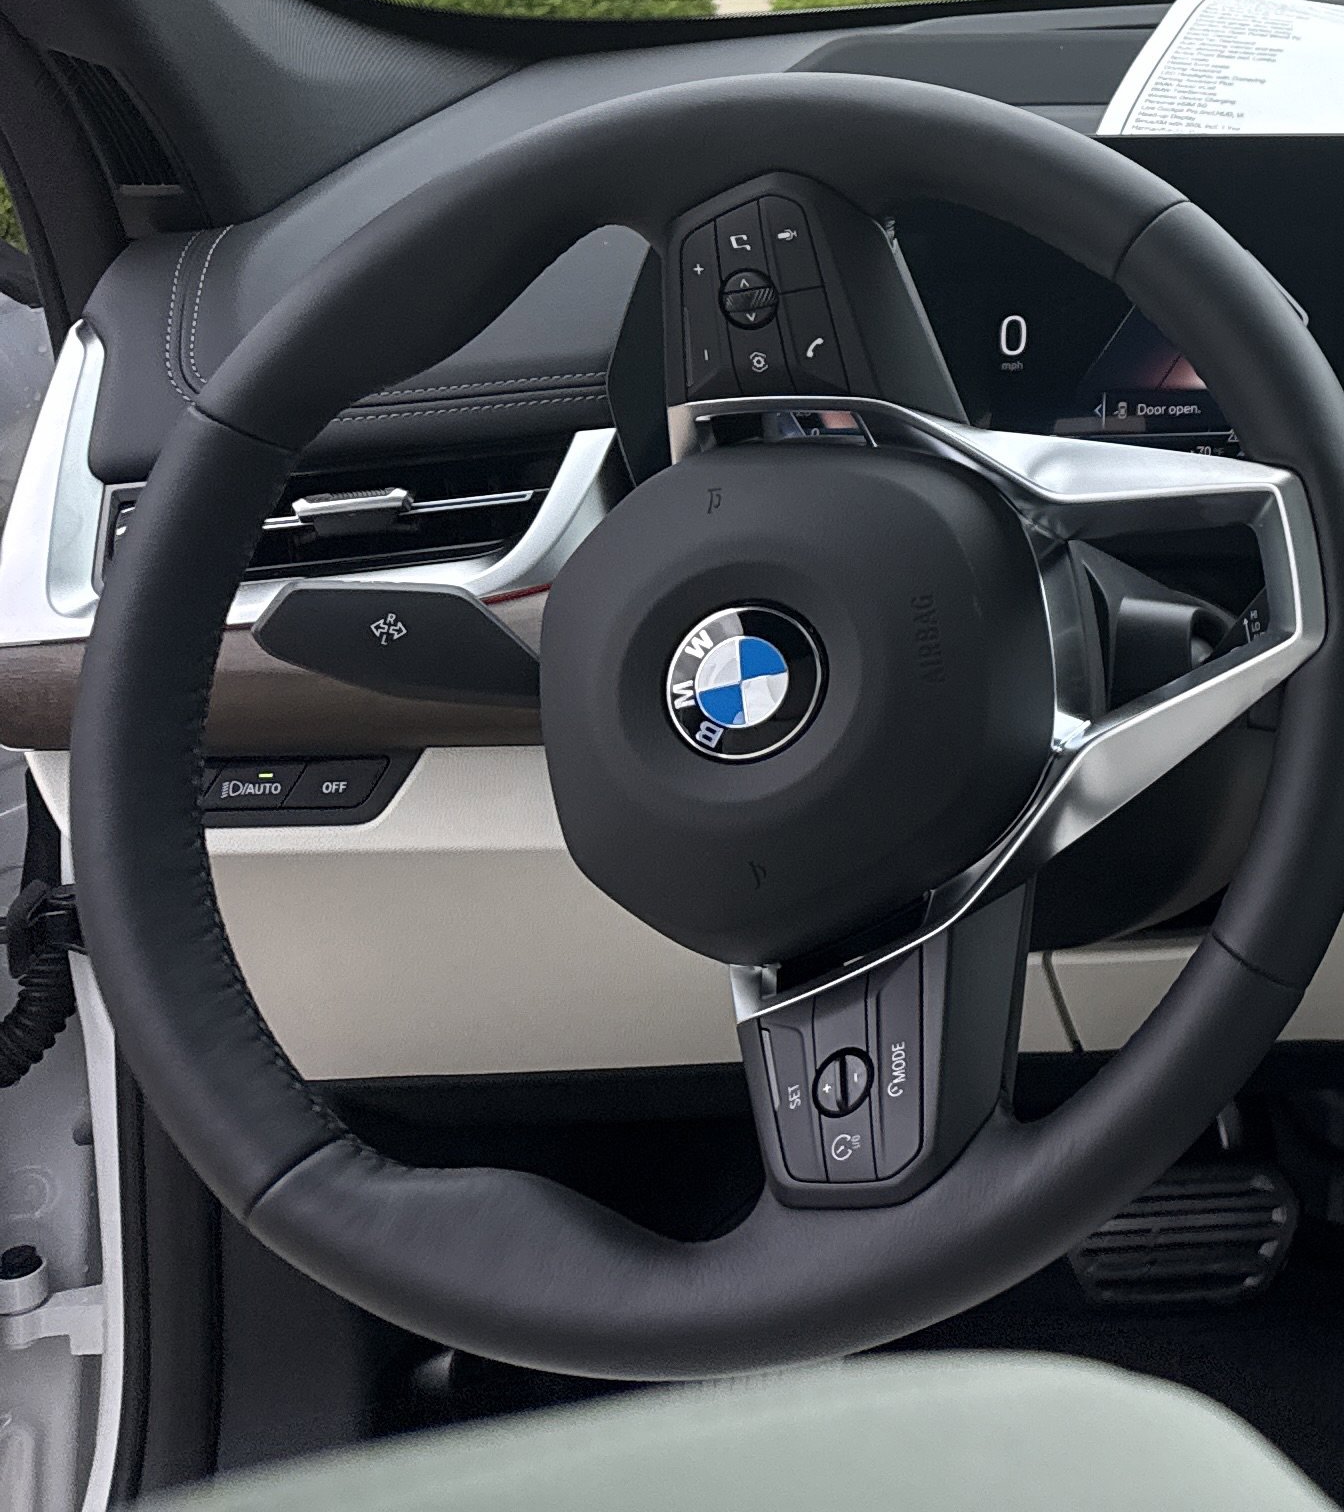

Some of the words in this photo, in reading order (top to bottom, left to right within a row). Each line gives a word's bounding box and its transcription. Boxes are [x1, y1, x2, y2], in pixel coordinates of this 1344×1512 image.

[1204, 97, 1236, 105] Charging
[999, 314, 1028, 356] 0
[1001, 360, 1024, 372] mph
[1138, 404, 1166, 416] Door
[1169, 405, 1201, 416] open.
[387, 613, 396, 624] R
[1252, 622, 1261, 631] LO
[381, 636, 388, 646] L
[910, 591, 947, 686] AIRBAG
[672, 629, 724, 749] BMW
[322, 781, 347, 794] OFF
[891, 1042, 906, 1084] MODE
[788, 1084, 801, 1110] SET
